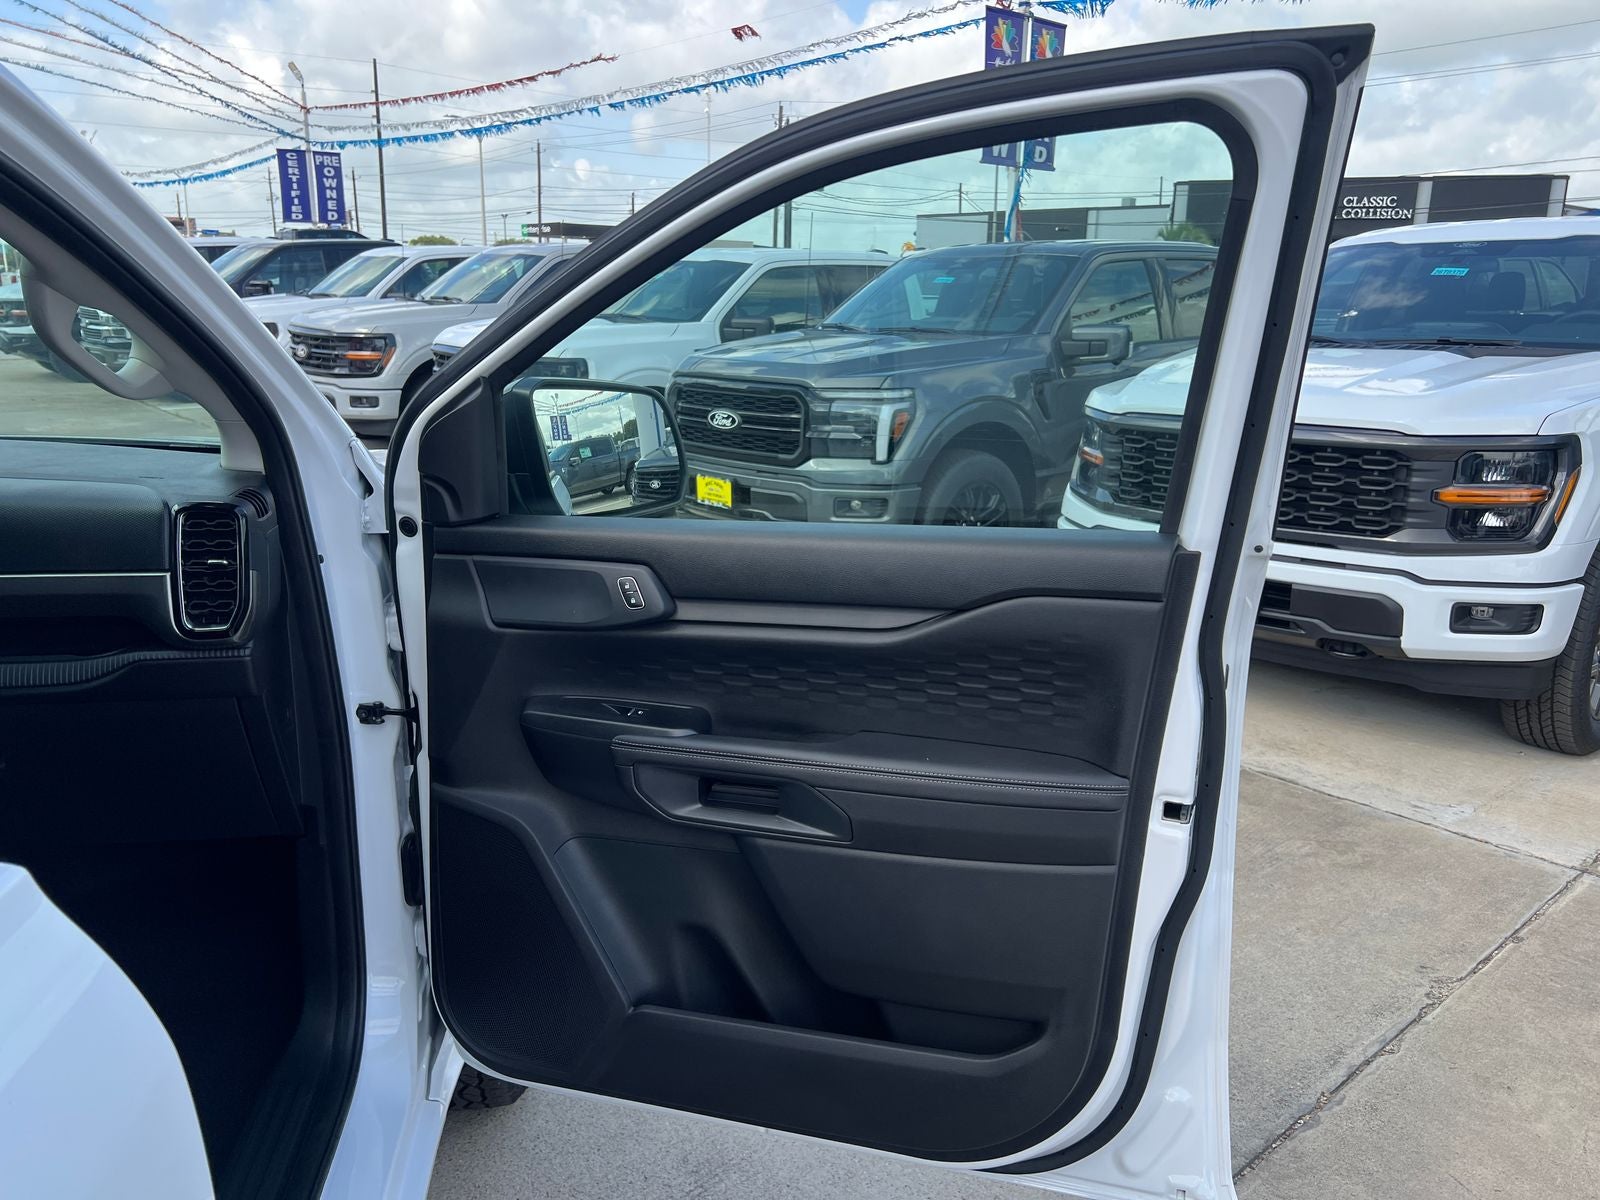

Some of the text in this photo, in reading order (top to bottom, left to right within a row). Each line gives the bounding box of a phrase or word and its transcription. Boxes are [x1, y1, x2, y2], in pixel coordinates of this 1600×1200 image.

[314, 154, 340, 167] PRE
[285, 152, 303, 220] CERTIFIED
[322, 167, 339, 221] OWNED
[1343, 196, 1398, 207] CLASSIC
[1341, 208, 1413, 219] COLLISION
